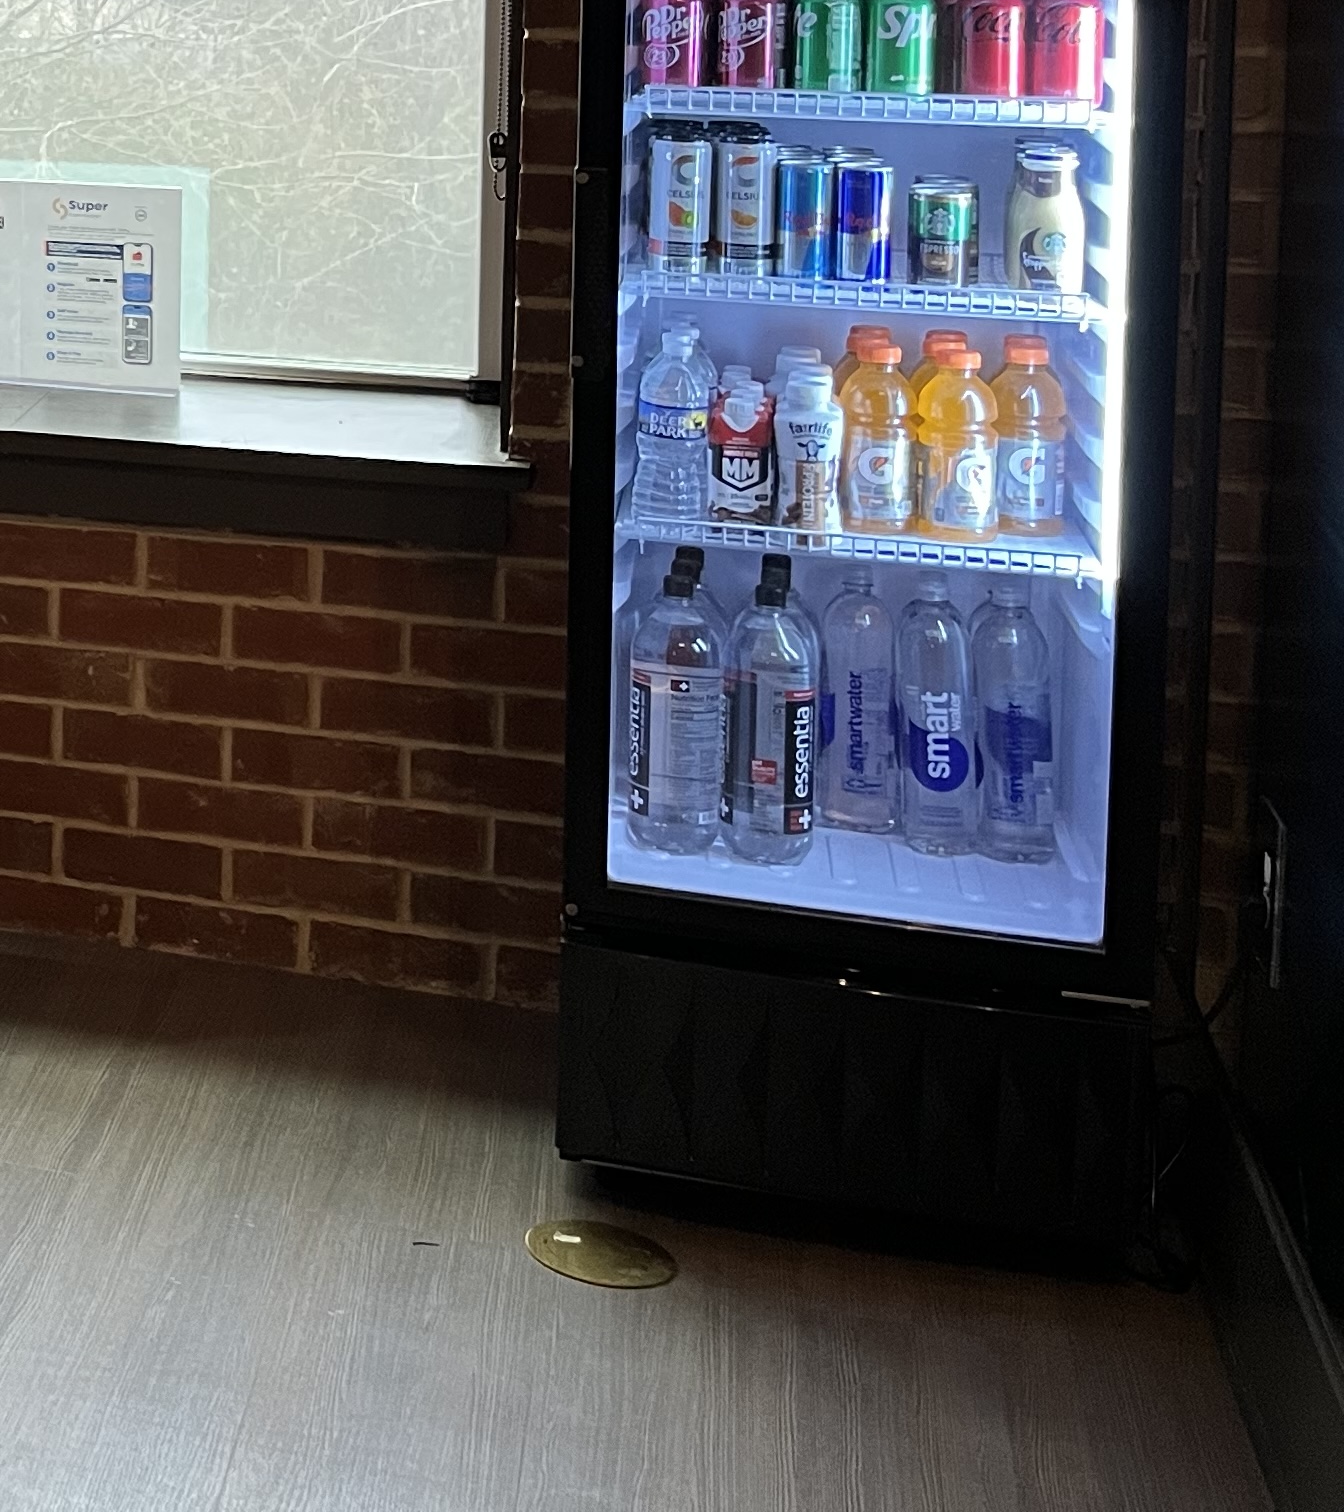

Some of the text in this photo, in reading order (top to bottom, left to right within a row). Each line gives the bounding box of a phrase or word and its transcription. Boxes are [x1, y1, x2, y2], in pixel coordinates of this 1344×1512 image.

[877, 4, 936, 48] Spr
[69, 199, 108, 211] Super
[649, 423, 687, 439] PARK
[650, 413, 685, 426] DEER
[789, 422, 832, 437] fairlife
[1009, 448, 1046, 485] G
[848, 671, 864, 773] smartwater
[950, 692, 961, 731] water
[630, 687, 641, 776] essentia
[920, 691, 950, 779] smart
[794, 706, 809, 798] essentia
